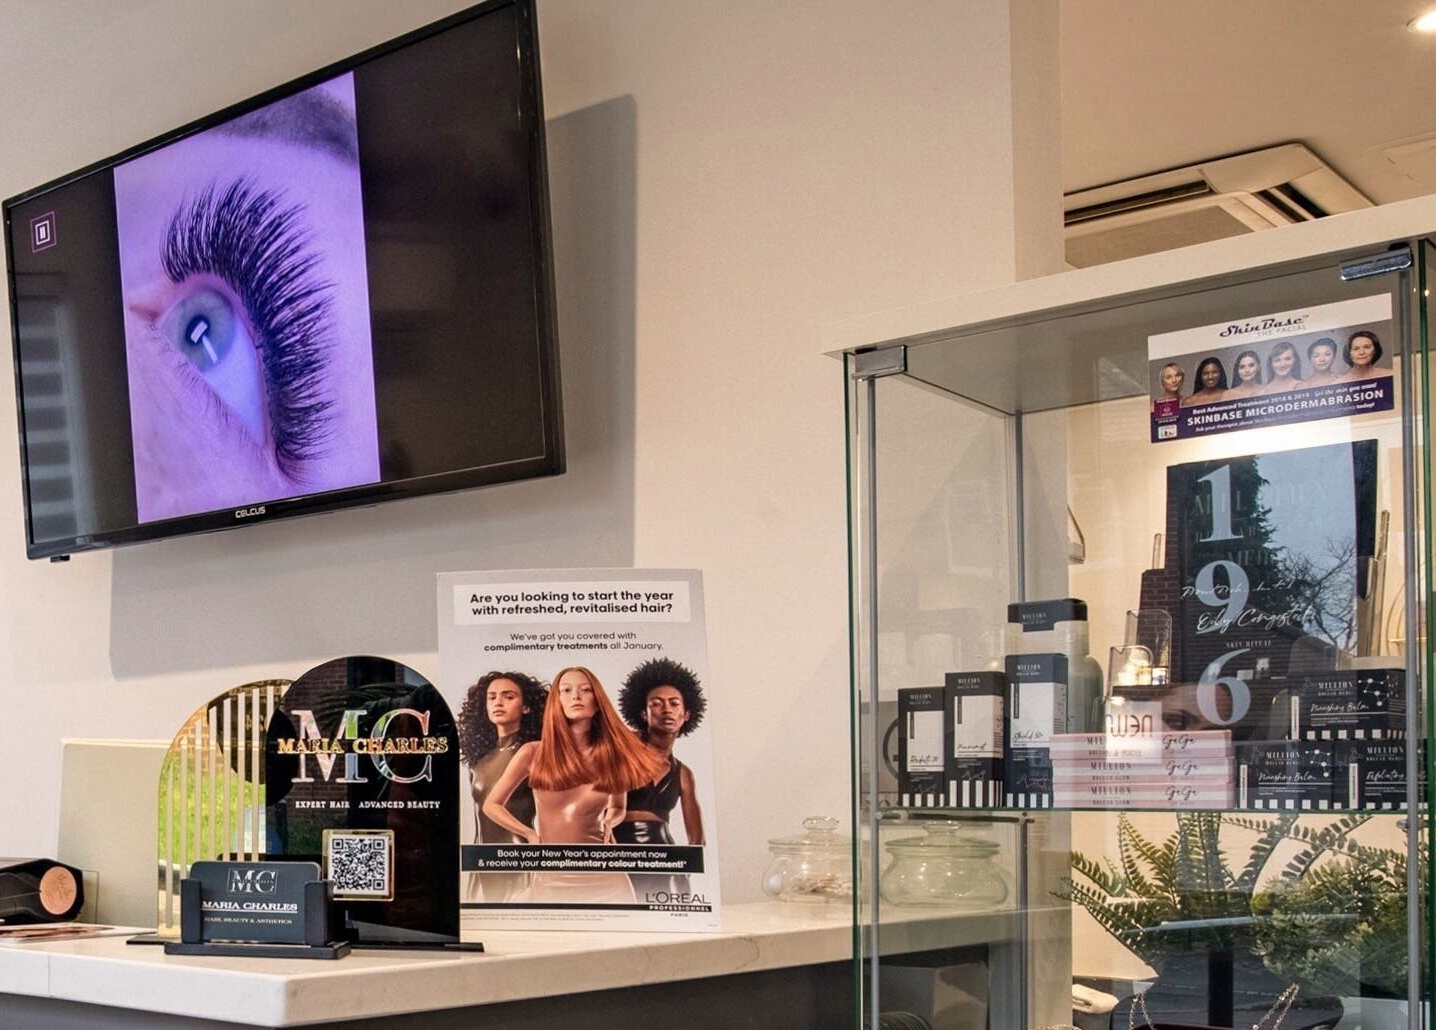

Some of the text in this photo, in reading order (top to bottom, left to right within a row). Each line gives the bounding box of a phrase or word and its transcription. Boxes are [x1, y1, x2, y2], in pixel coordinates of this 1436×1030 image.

[1187, 409, 1243, 426] SKINBASE
[1246, 390, 1384, 418] MICRODERMABRASION
[1193, 406, 1205, 414] Best
[1207, 403, 1237, 413] Advanced
[235, 506, 265, 518] CELCUS
[470, 591, 673, 604] Are you looking to start the year
[472, 603, 673, 615] with refreshed, revitalised hair?
[510, 632, 636, 642] We've got you covered with
[484, 643, 555, 652] complimentary
[557, 642, 608, 650] treatments
[624, 642, 664, 651] January.
[277, 736, 449, 754] MARIA CHARLES
[291, 708, 432, 783] MC
[295, 801, 441, 809] EXPERT HAIR ADVANCED BEAUTY
[497, 849, 519, 858] Book
[521, 851, 540, 860] your
[542, 850, 561, 858] New
[563, 850, 589, 858] Year's
[591, 850, 646, 860] appointment
[478, 859, 484, 867] &
[541, 859, 607, 869] complimentary
[230, 870, 275, 893] MC
[202, 901, 297, 911] MARIA CHARLES
